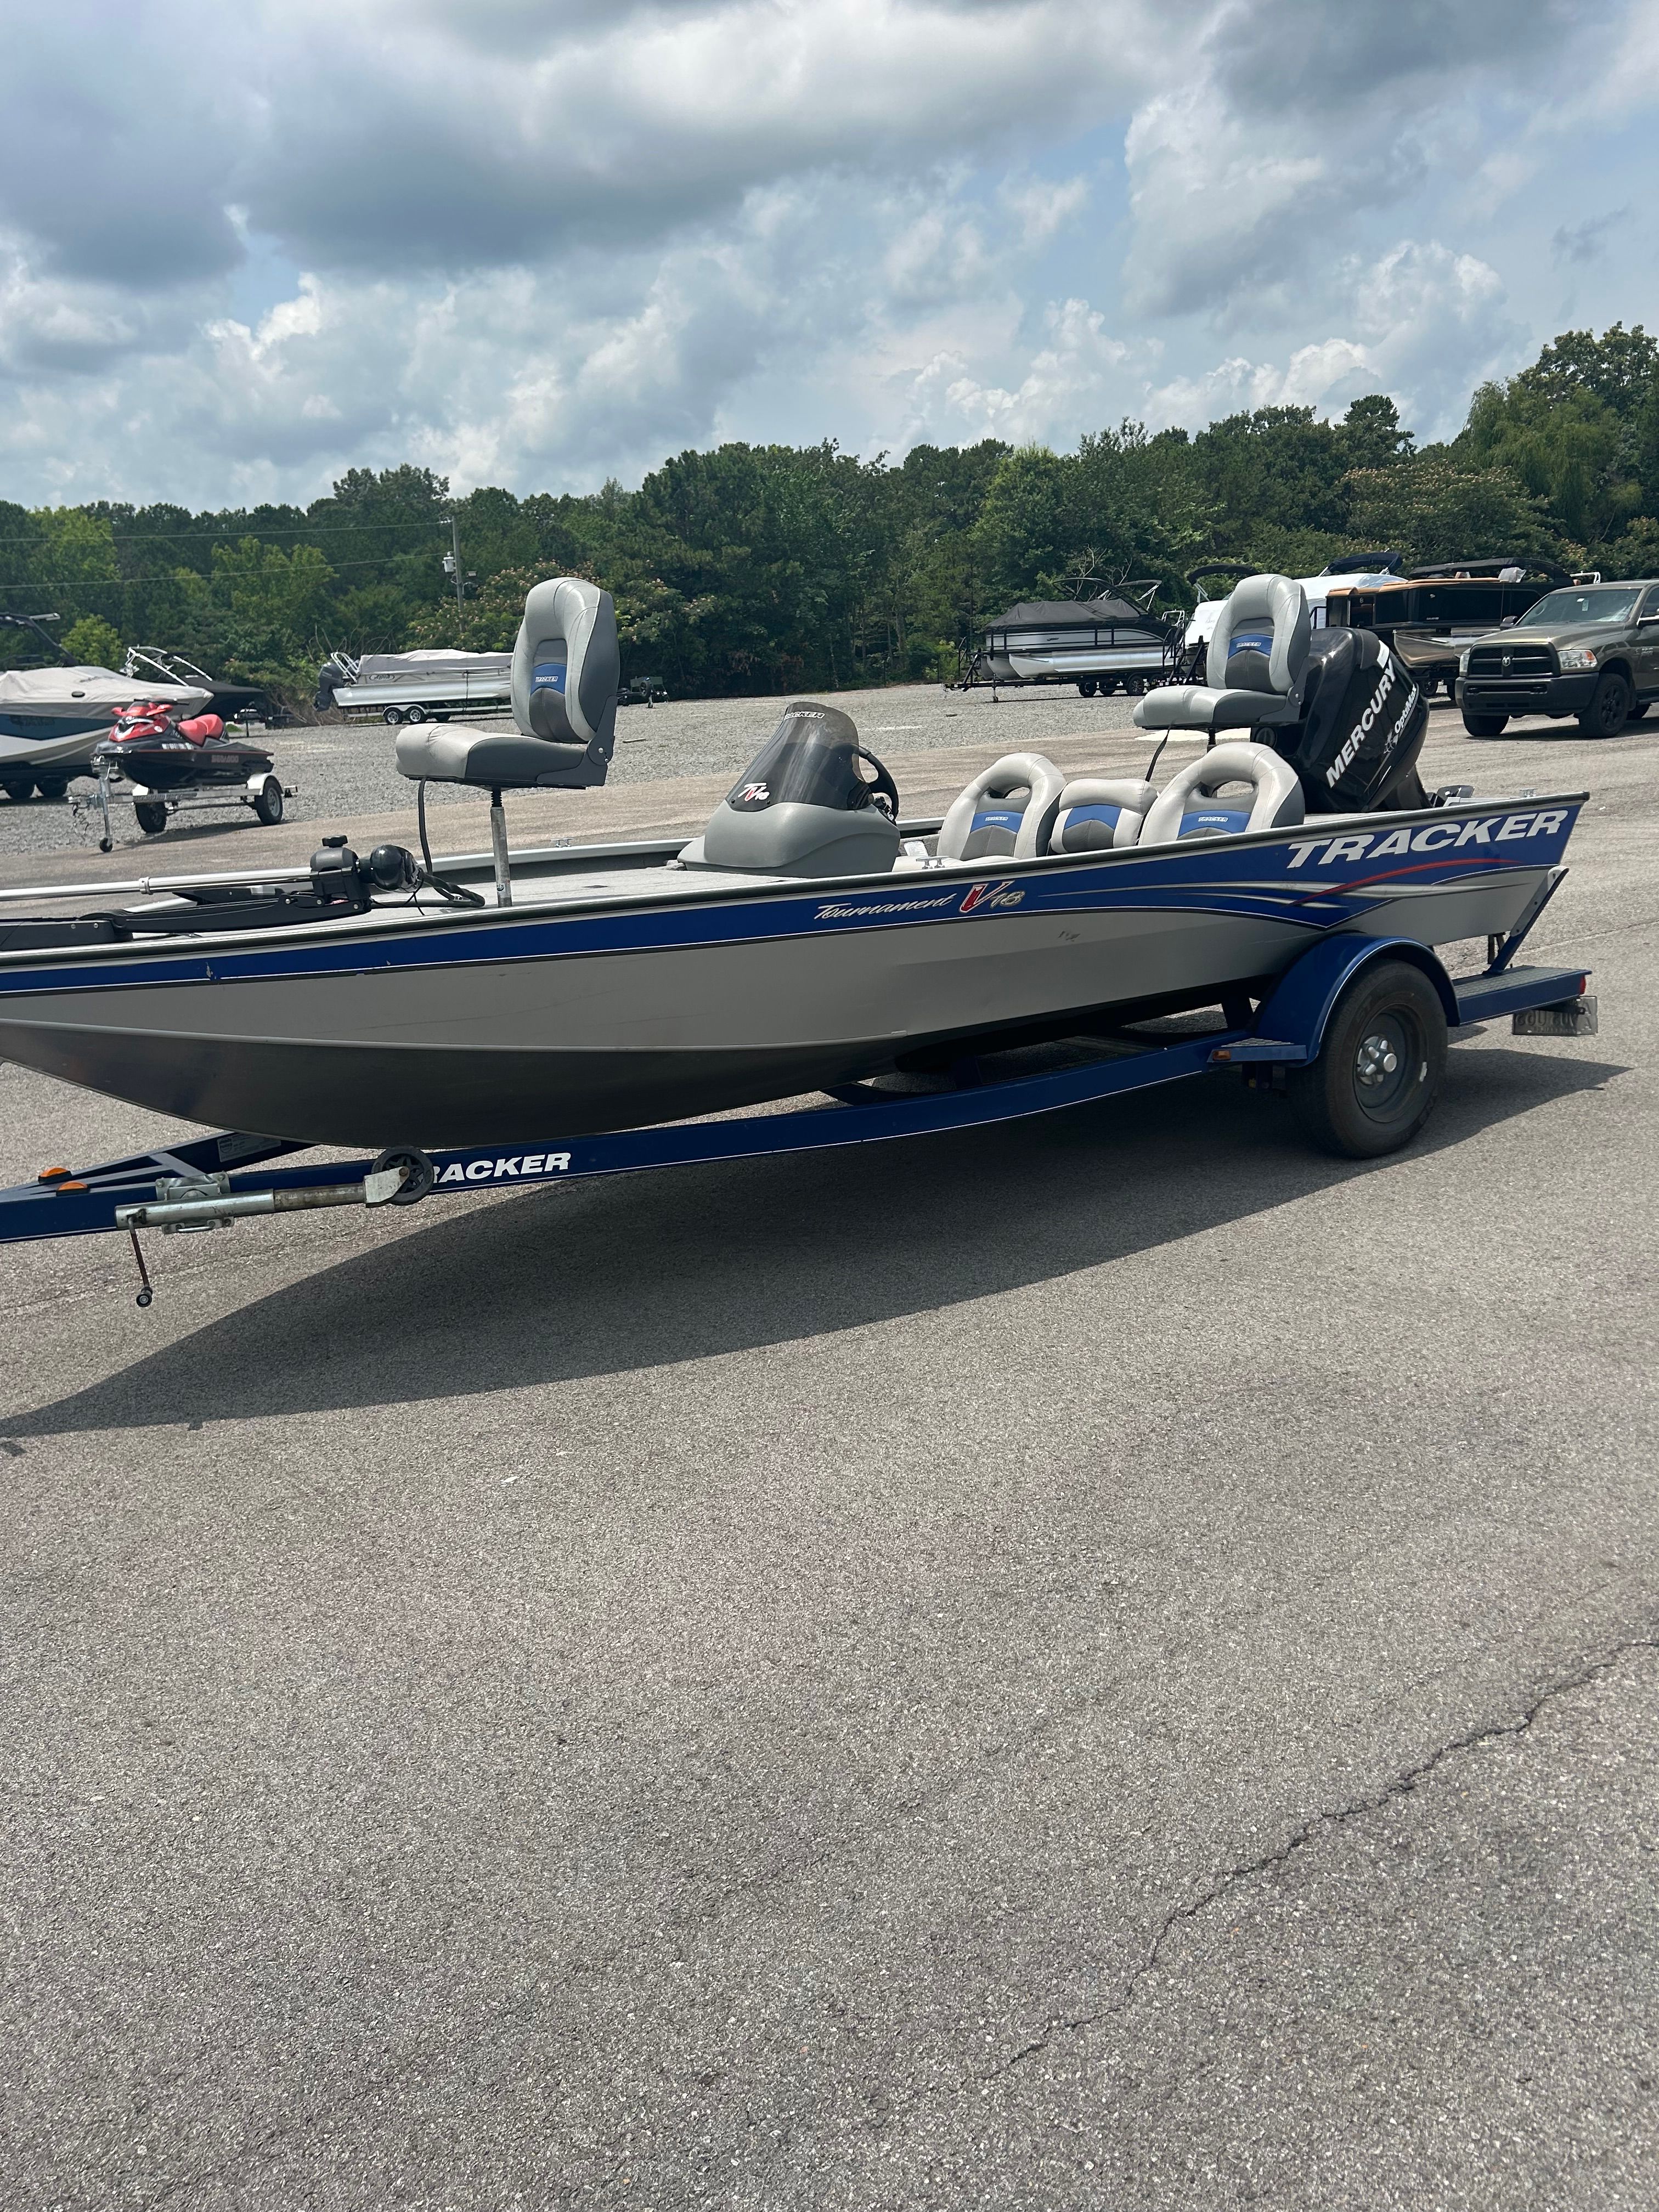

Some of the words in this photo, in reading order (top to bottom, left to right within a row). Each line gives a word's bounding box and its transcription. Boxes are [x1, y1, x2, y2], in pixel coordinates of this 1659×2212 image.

[1326, 658, 1396, 788] MERCURY
[1286, 809, 1569, 869] TRACKER
[814, 893, 957, 920] Tournament
[959, 880, 1025, 914] V18
[433, 1152, 572, 1184] ACKER
